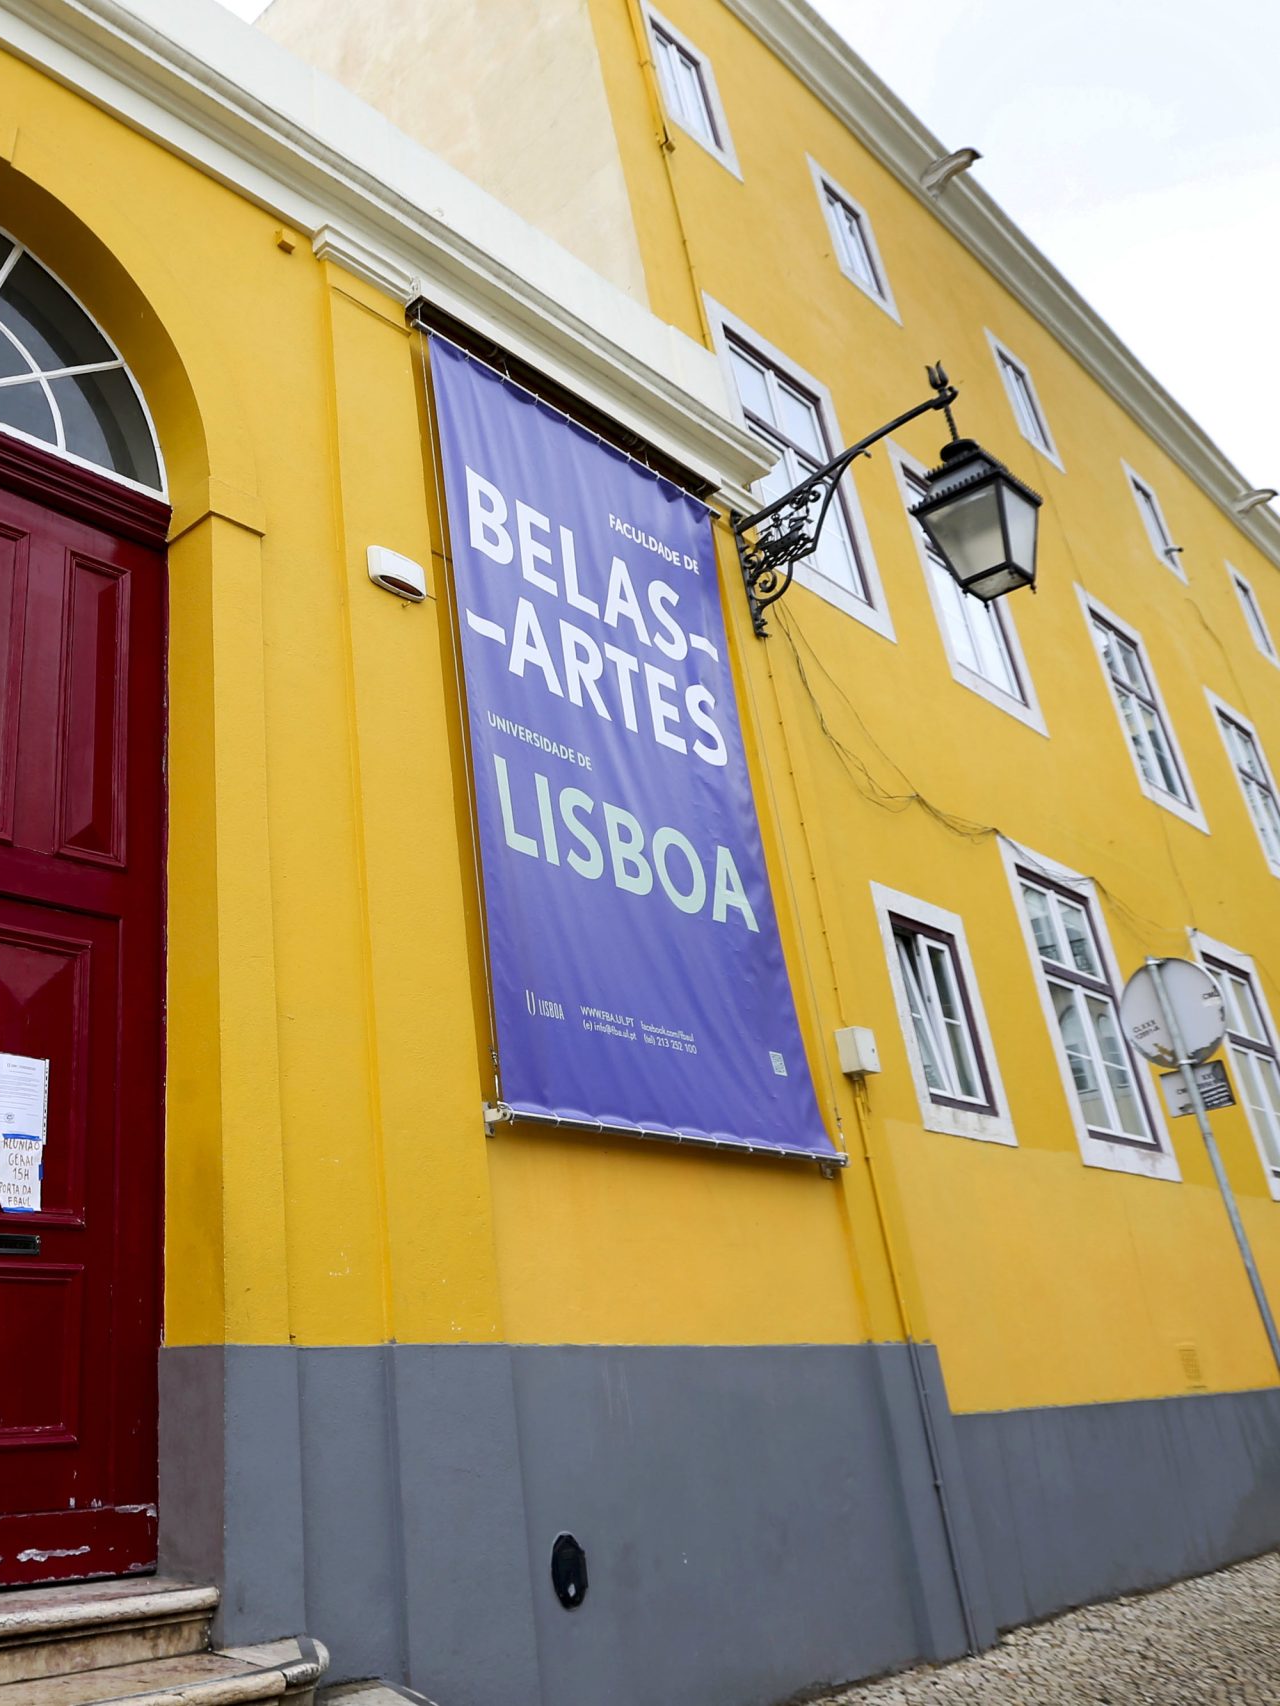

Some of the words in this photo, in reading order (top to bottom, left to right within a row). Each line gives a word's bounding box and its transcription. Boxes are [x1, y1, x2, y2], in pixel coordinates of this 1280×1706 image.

[608, 513, 681, 565] FACULDADE
[683, 554, 700, 576] DE
[487, 710, 576, 764] UNIVERSIDADE
[577, 753, 593, 771] DE
[493, 753, 760, 933] LISBOA
[538, 999, 565, 1020] LISBOA
[583, 1019, 593, 1032] (e)
[657, 1037, 670, 1048] 213
[670, 1040, 683, 1052] 252
[685, 1043, 698, 1055] 100
[8, 1152, 34, 1167] GERAL
[13, 1168, 30, 1181] 15H
[0, 1181, 20, 1195] PORTA
[22, 1185, 32, 1195] DA
